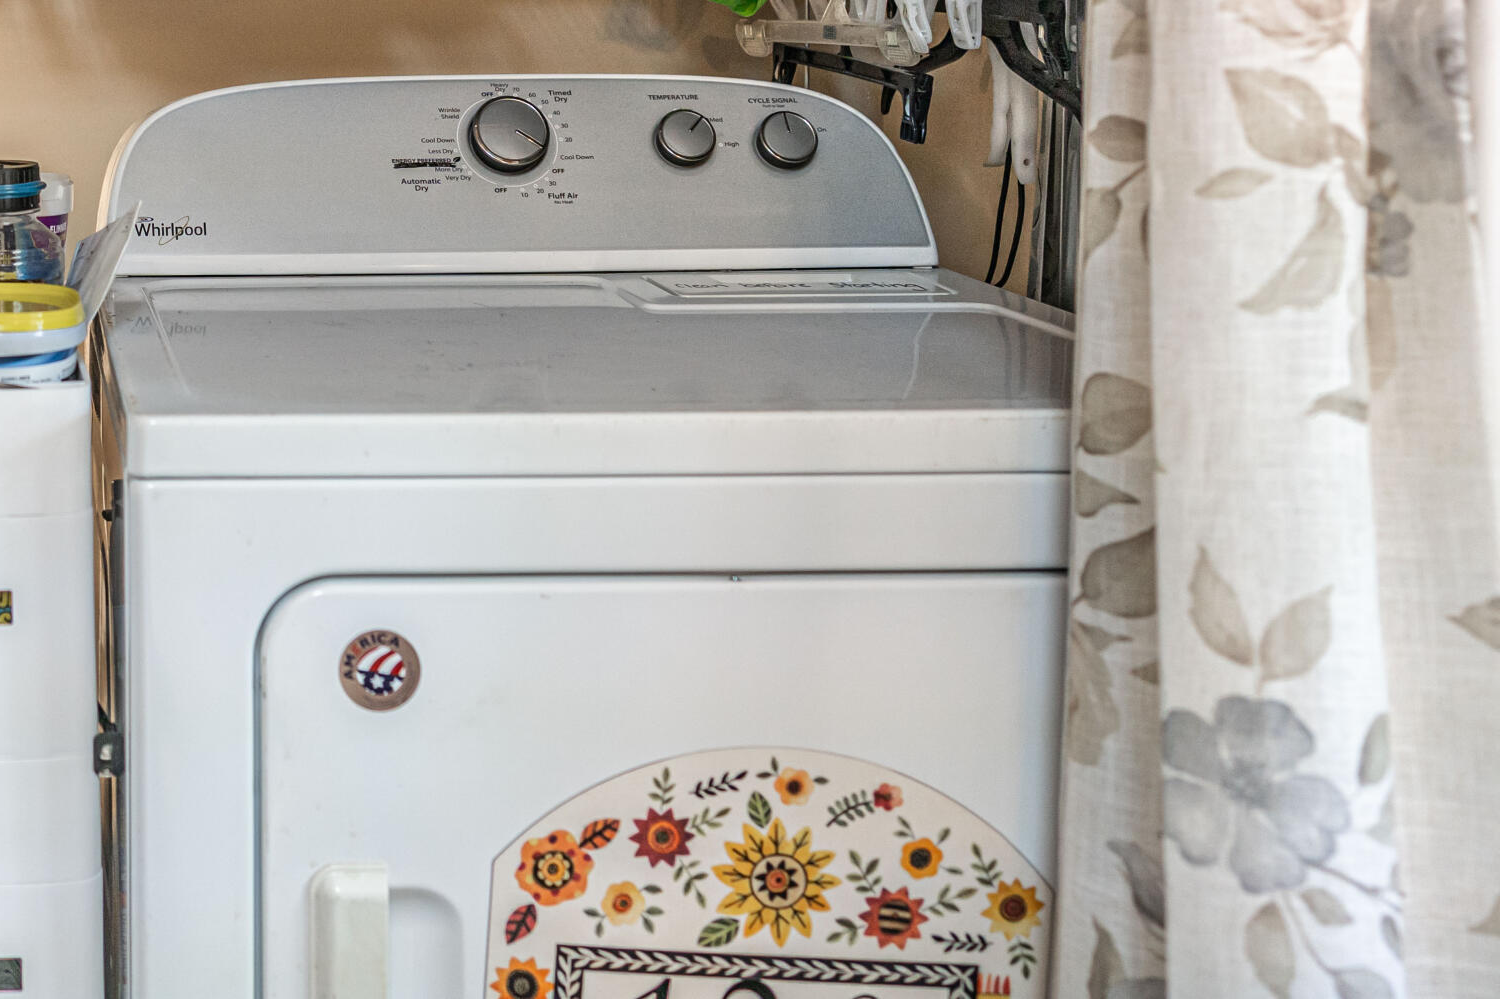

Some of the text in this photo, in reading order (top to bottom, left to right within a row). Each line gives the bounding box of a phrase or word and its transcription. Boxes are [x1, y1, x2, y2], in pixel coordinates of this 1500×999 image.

[414, 184, 429, 192] Dry
[134, 222, 208, 241] Whirlpool
[343, 632, 400, 680] AMERICA
